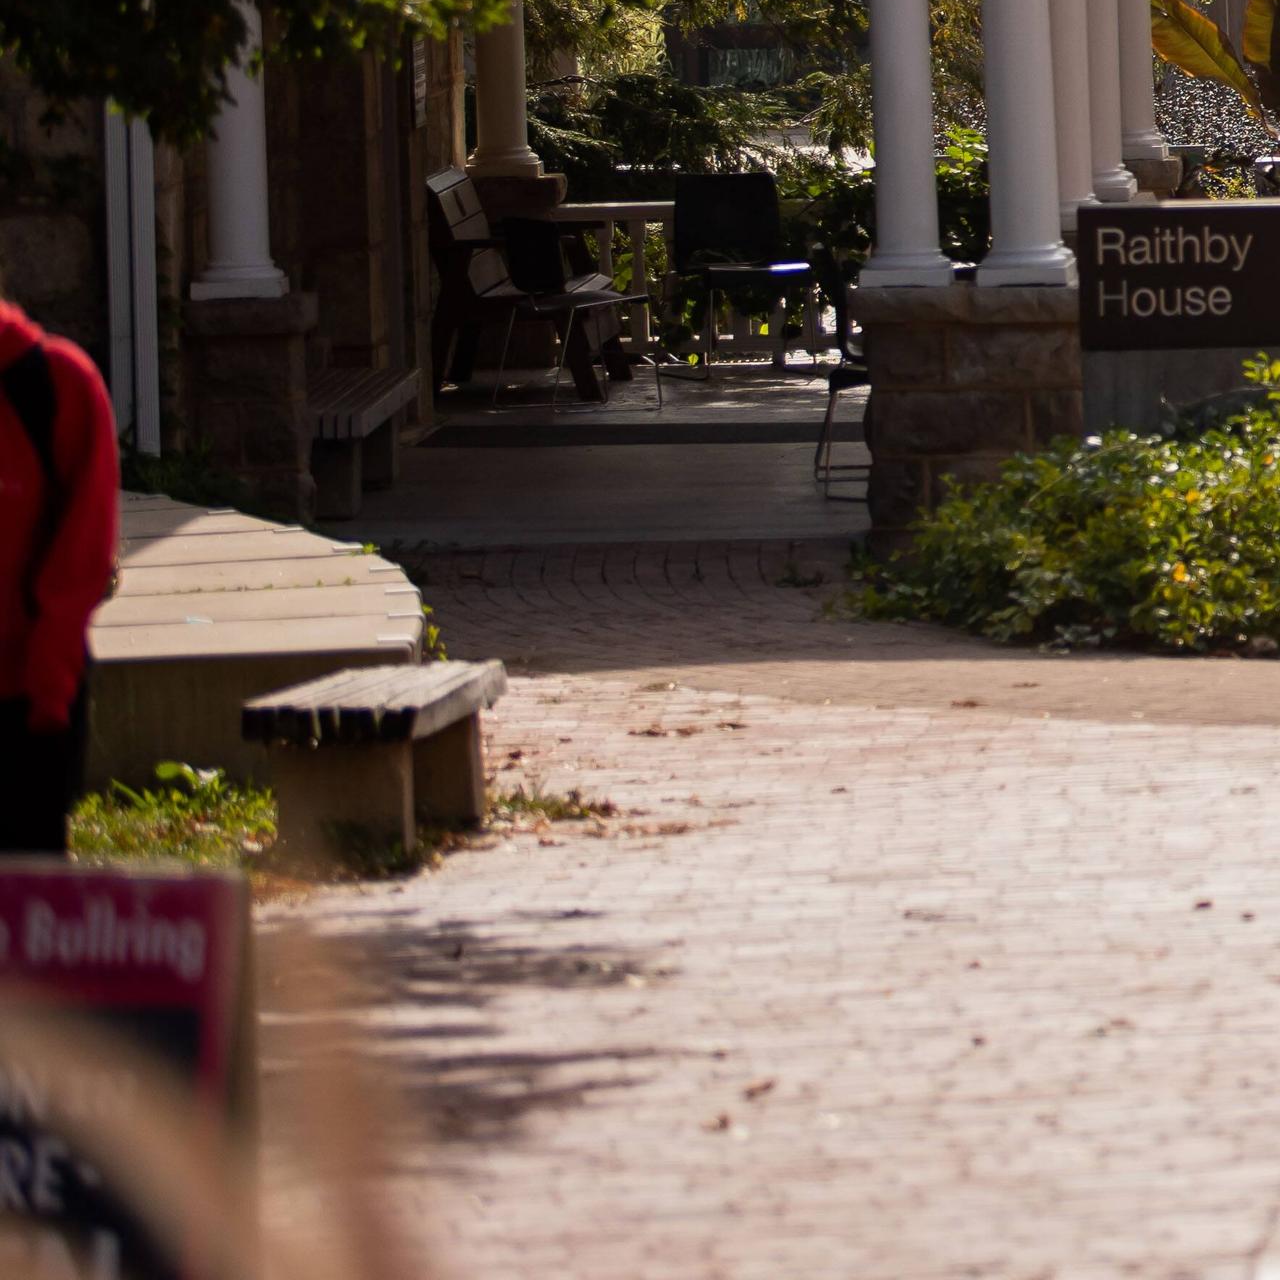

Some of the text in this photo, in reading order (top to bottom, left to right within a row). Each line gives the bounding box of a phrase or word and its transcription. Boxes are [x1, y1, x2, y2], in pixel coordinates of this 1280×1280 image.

[1096, 226, 1252, 271] Raithby
[1099, 280, 1232, 317] House
[24, 896, 207, 983] Bullring
